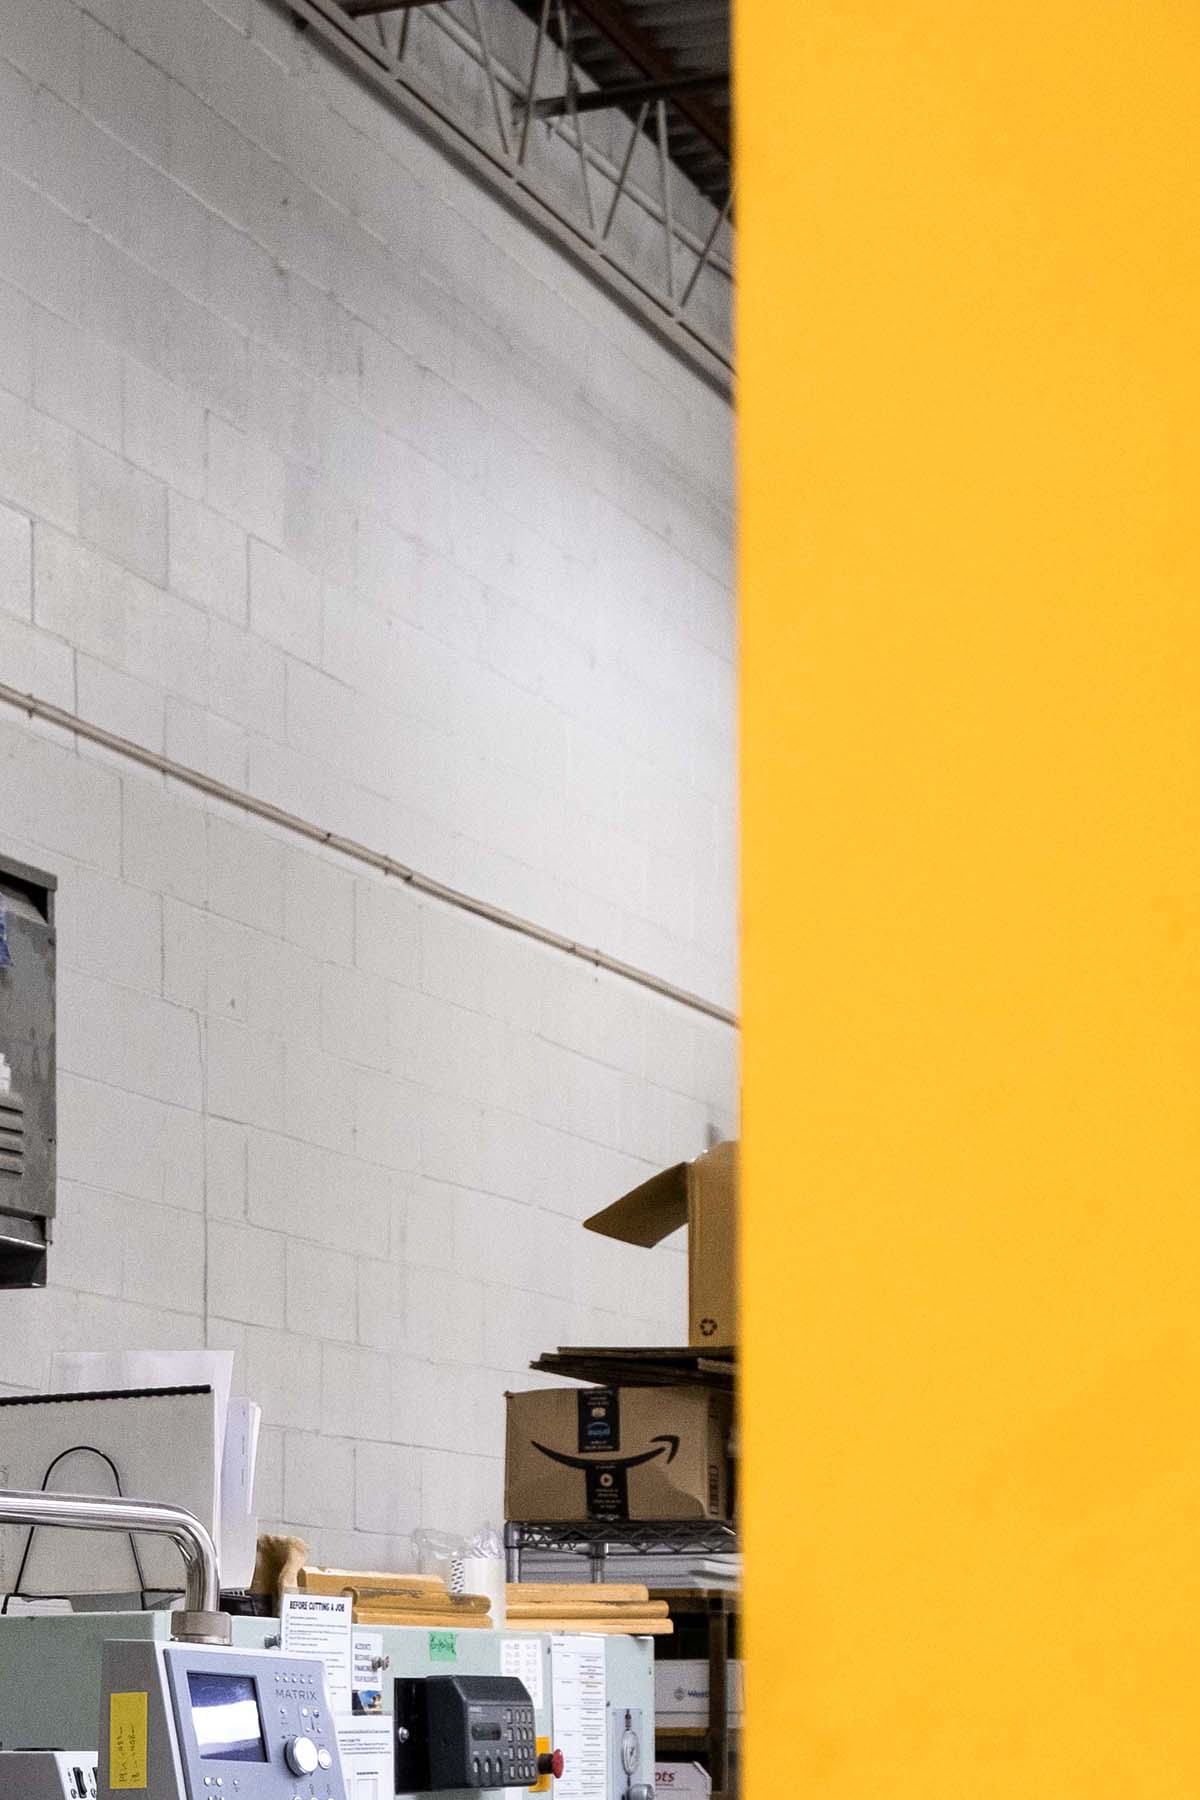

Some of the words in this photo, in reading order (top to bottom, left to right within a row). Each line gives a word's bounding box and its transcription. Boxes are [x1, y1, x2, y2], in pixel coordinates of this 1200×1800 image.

[290, 1600, 308, 1610] BEFORE
[309, 1601, 330, 1611] CUTTING
[335, 1602, 345, 1612] JOB
[275, 1688, 318, 1701] MATRIX
